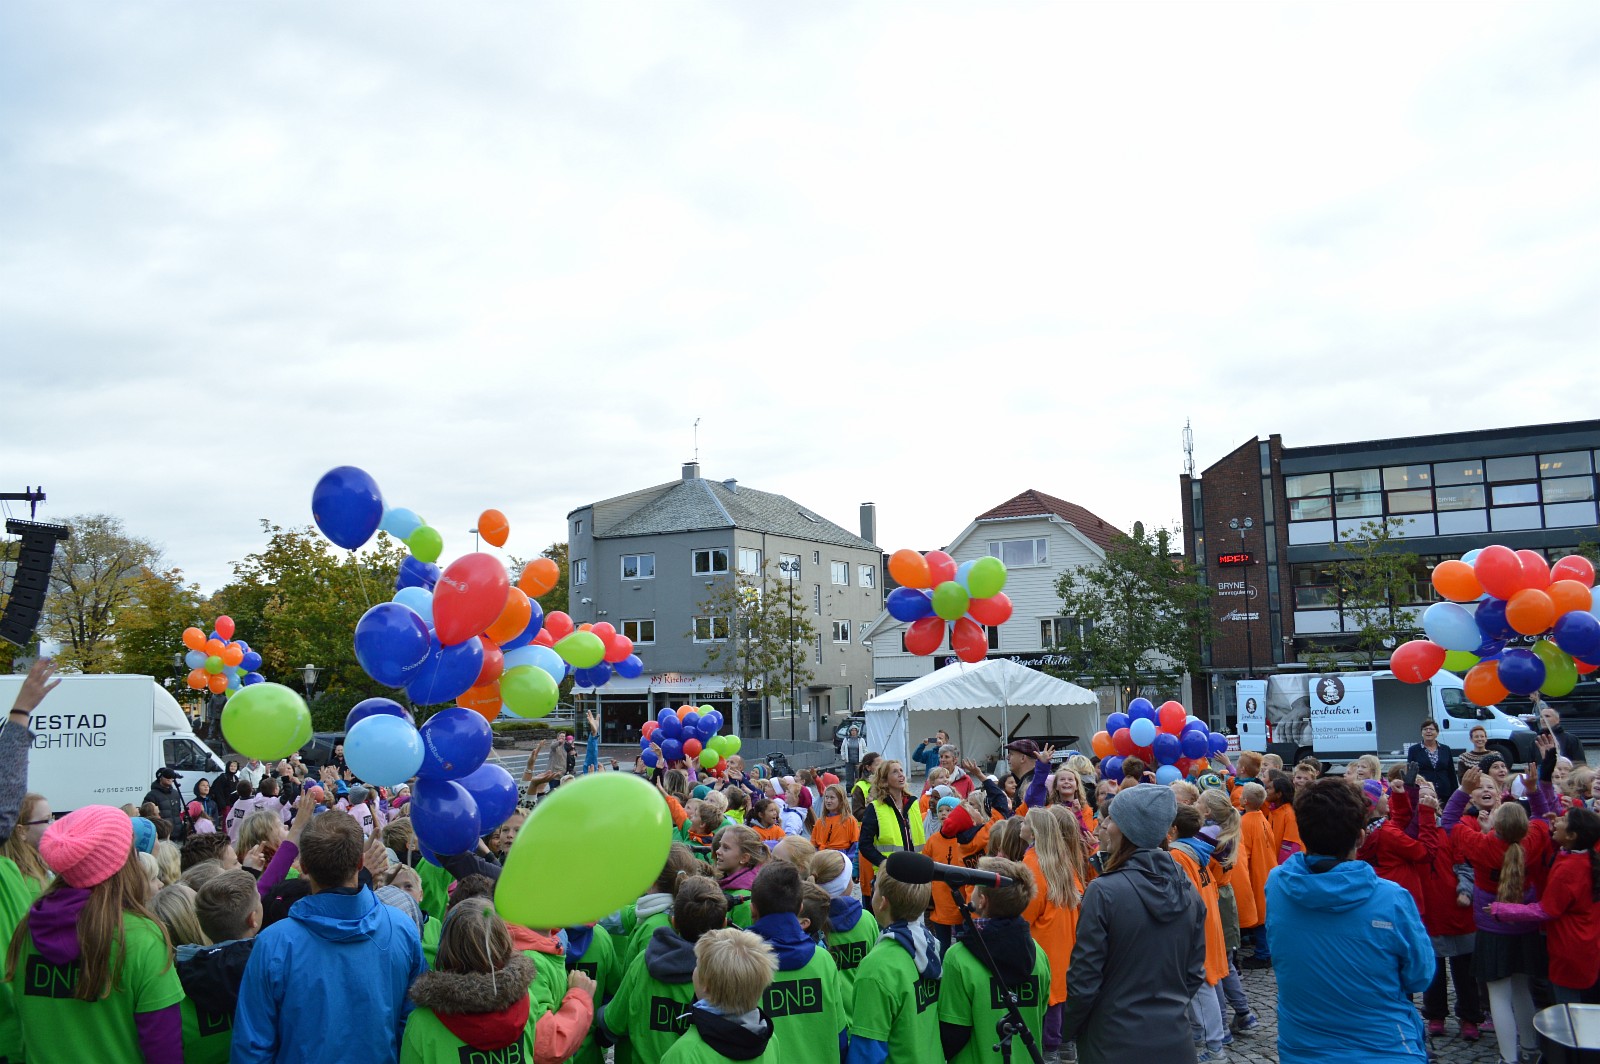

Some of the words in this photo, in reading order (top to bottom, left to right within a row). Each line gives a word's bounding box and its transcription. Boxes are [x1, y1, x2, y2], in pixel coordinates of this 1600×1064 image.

[1218, 581, 1245, 590] BRYNE
[30, 732, 107, 749] GHTING
[425, 727, 444, 764] SpareBank
[831, 943, 863, 970] DNB
[769, 980, 816, 1016] DNB
[918, 978, 937, 1005] DNB
[469, 1043, 521, 1064] DNB
